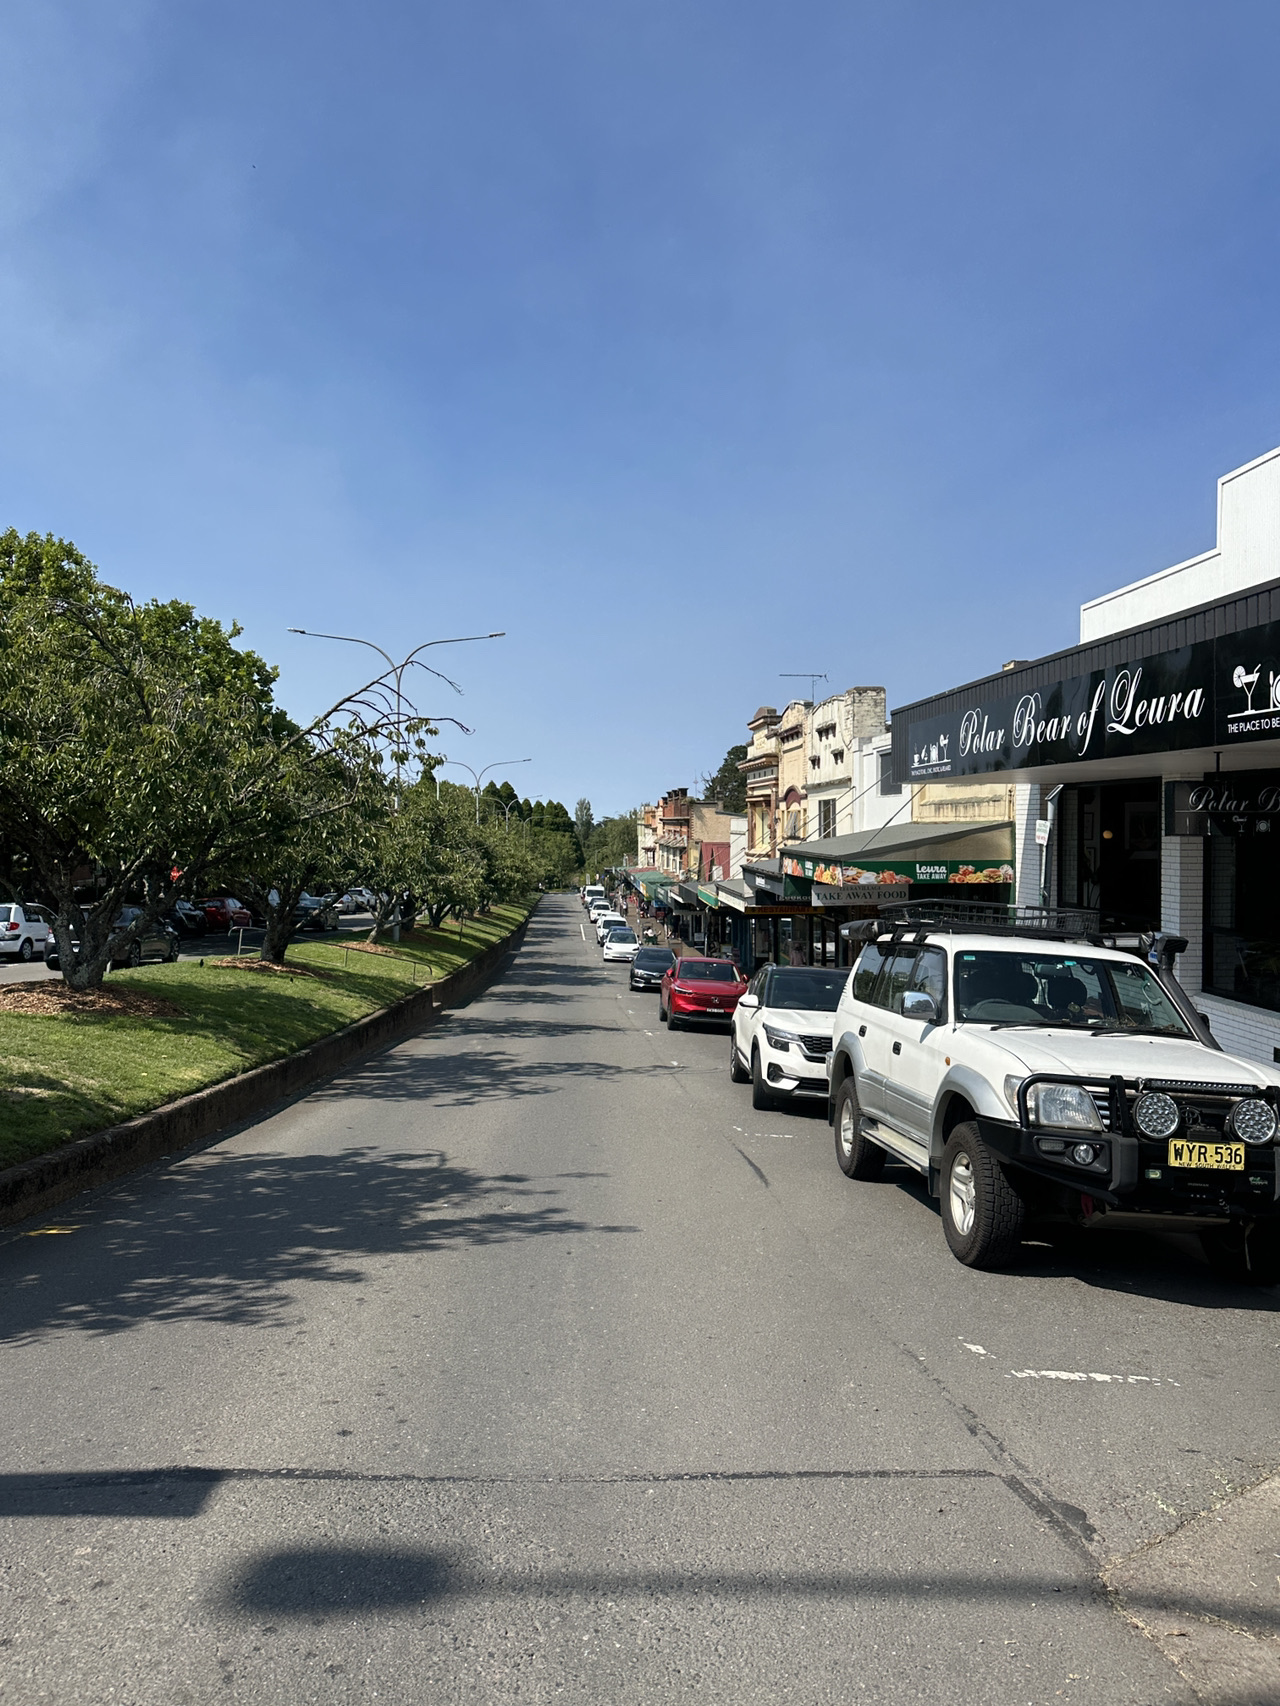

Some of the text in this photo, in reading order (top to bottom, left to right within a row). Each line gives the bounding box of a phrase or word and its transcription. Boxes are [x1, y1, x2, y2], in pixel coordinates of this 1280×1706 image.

[959, 667, 1205, 757] Polar Bear of Leura
[1227, 717, 1280, 733] THE PLACE TO BE
[1188, 785, 1250, 812] Polar
[916, 863, 947, 873] Leura
[815, 892, 843, 900] TAKE
[846, 891, 874, 900] AWAY
[877, 890, 907, 899] FOOD
